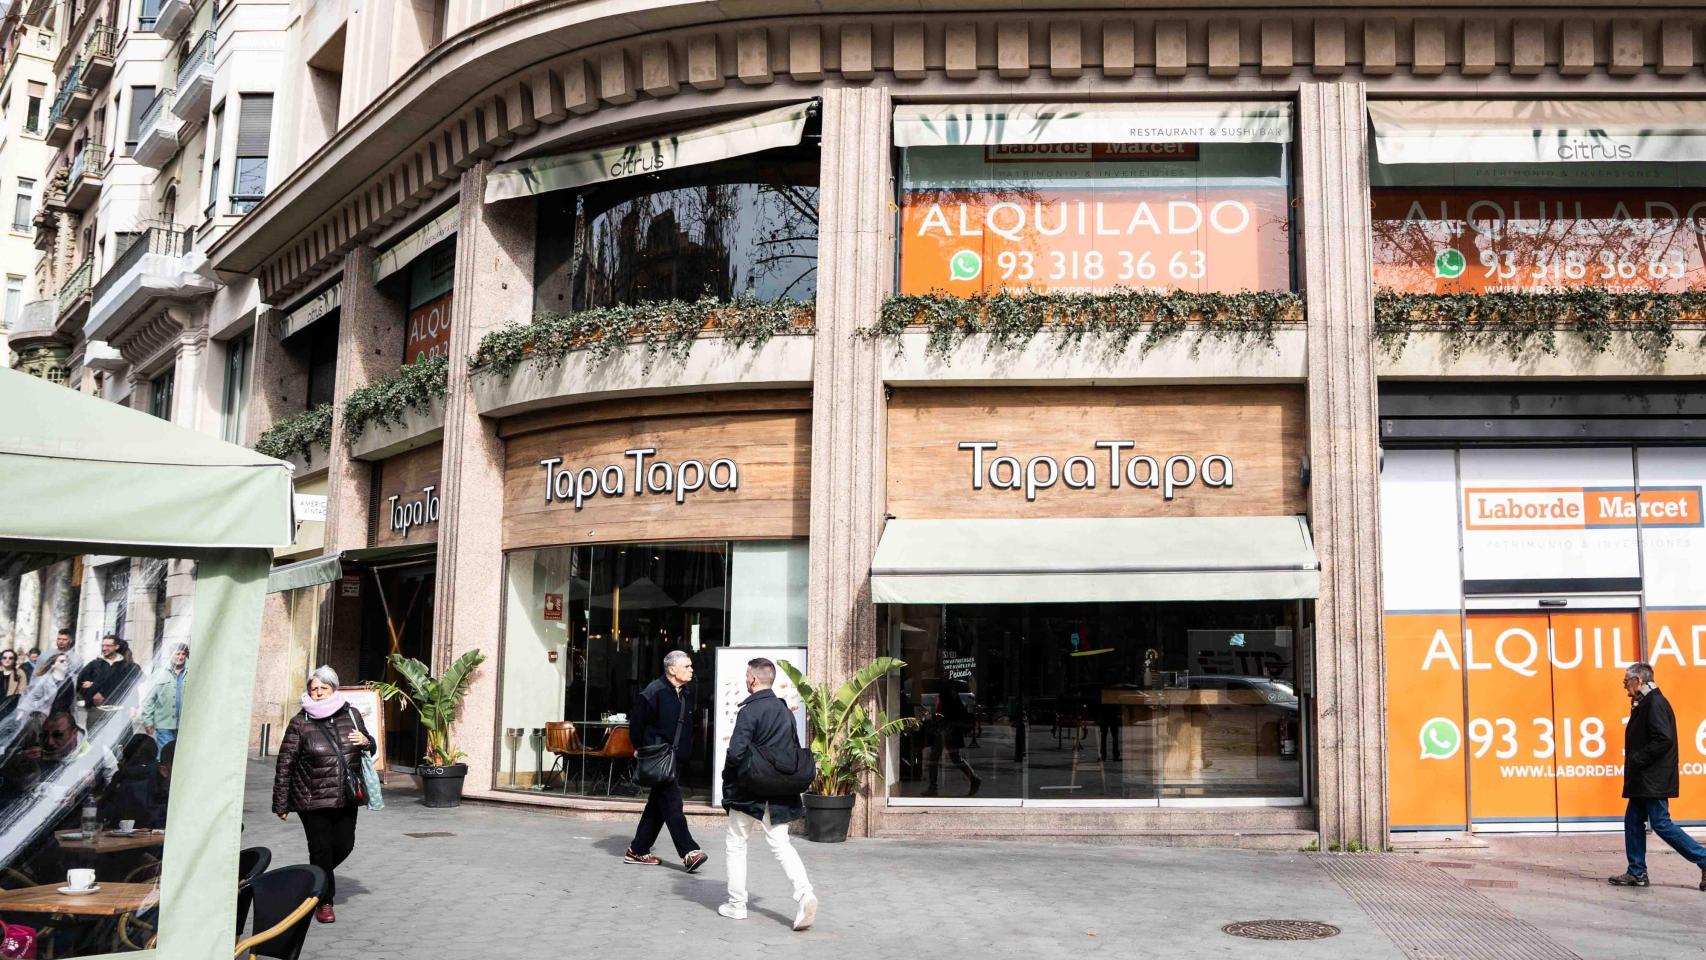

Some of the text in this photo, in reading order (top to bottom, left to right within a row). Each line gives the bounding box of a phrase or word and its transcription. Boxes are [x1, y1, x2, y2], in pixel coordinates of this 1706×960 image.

[1129, 127, 1282, 137] RESTAURANT & SUSHI BAR
[1557, 138, 1633, 160] citrus
[610, 154, 664, 178] citrus
[917, 200, 1250, 241] ALQUILADO
[997, 249, 1207, 280] 93 318 36 63
[1479, 249, 1685, 280] 93 318 36 63
[1477, 496, 1688, 519] Laborde Marcet
[1468, 717, 1518, 759] 93
[1532, 716, 1607, 759] 318
